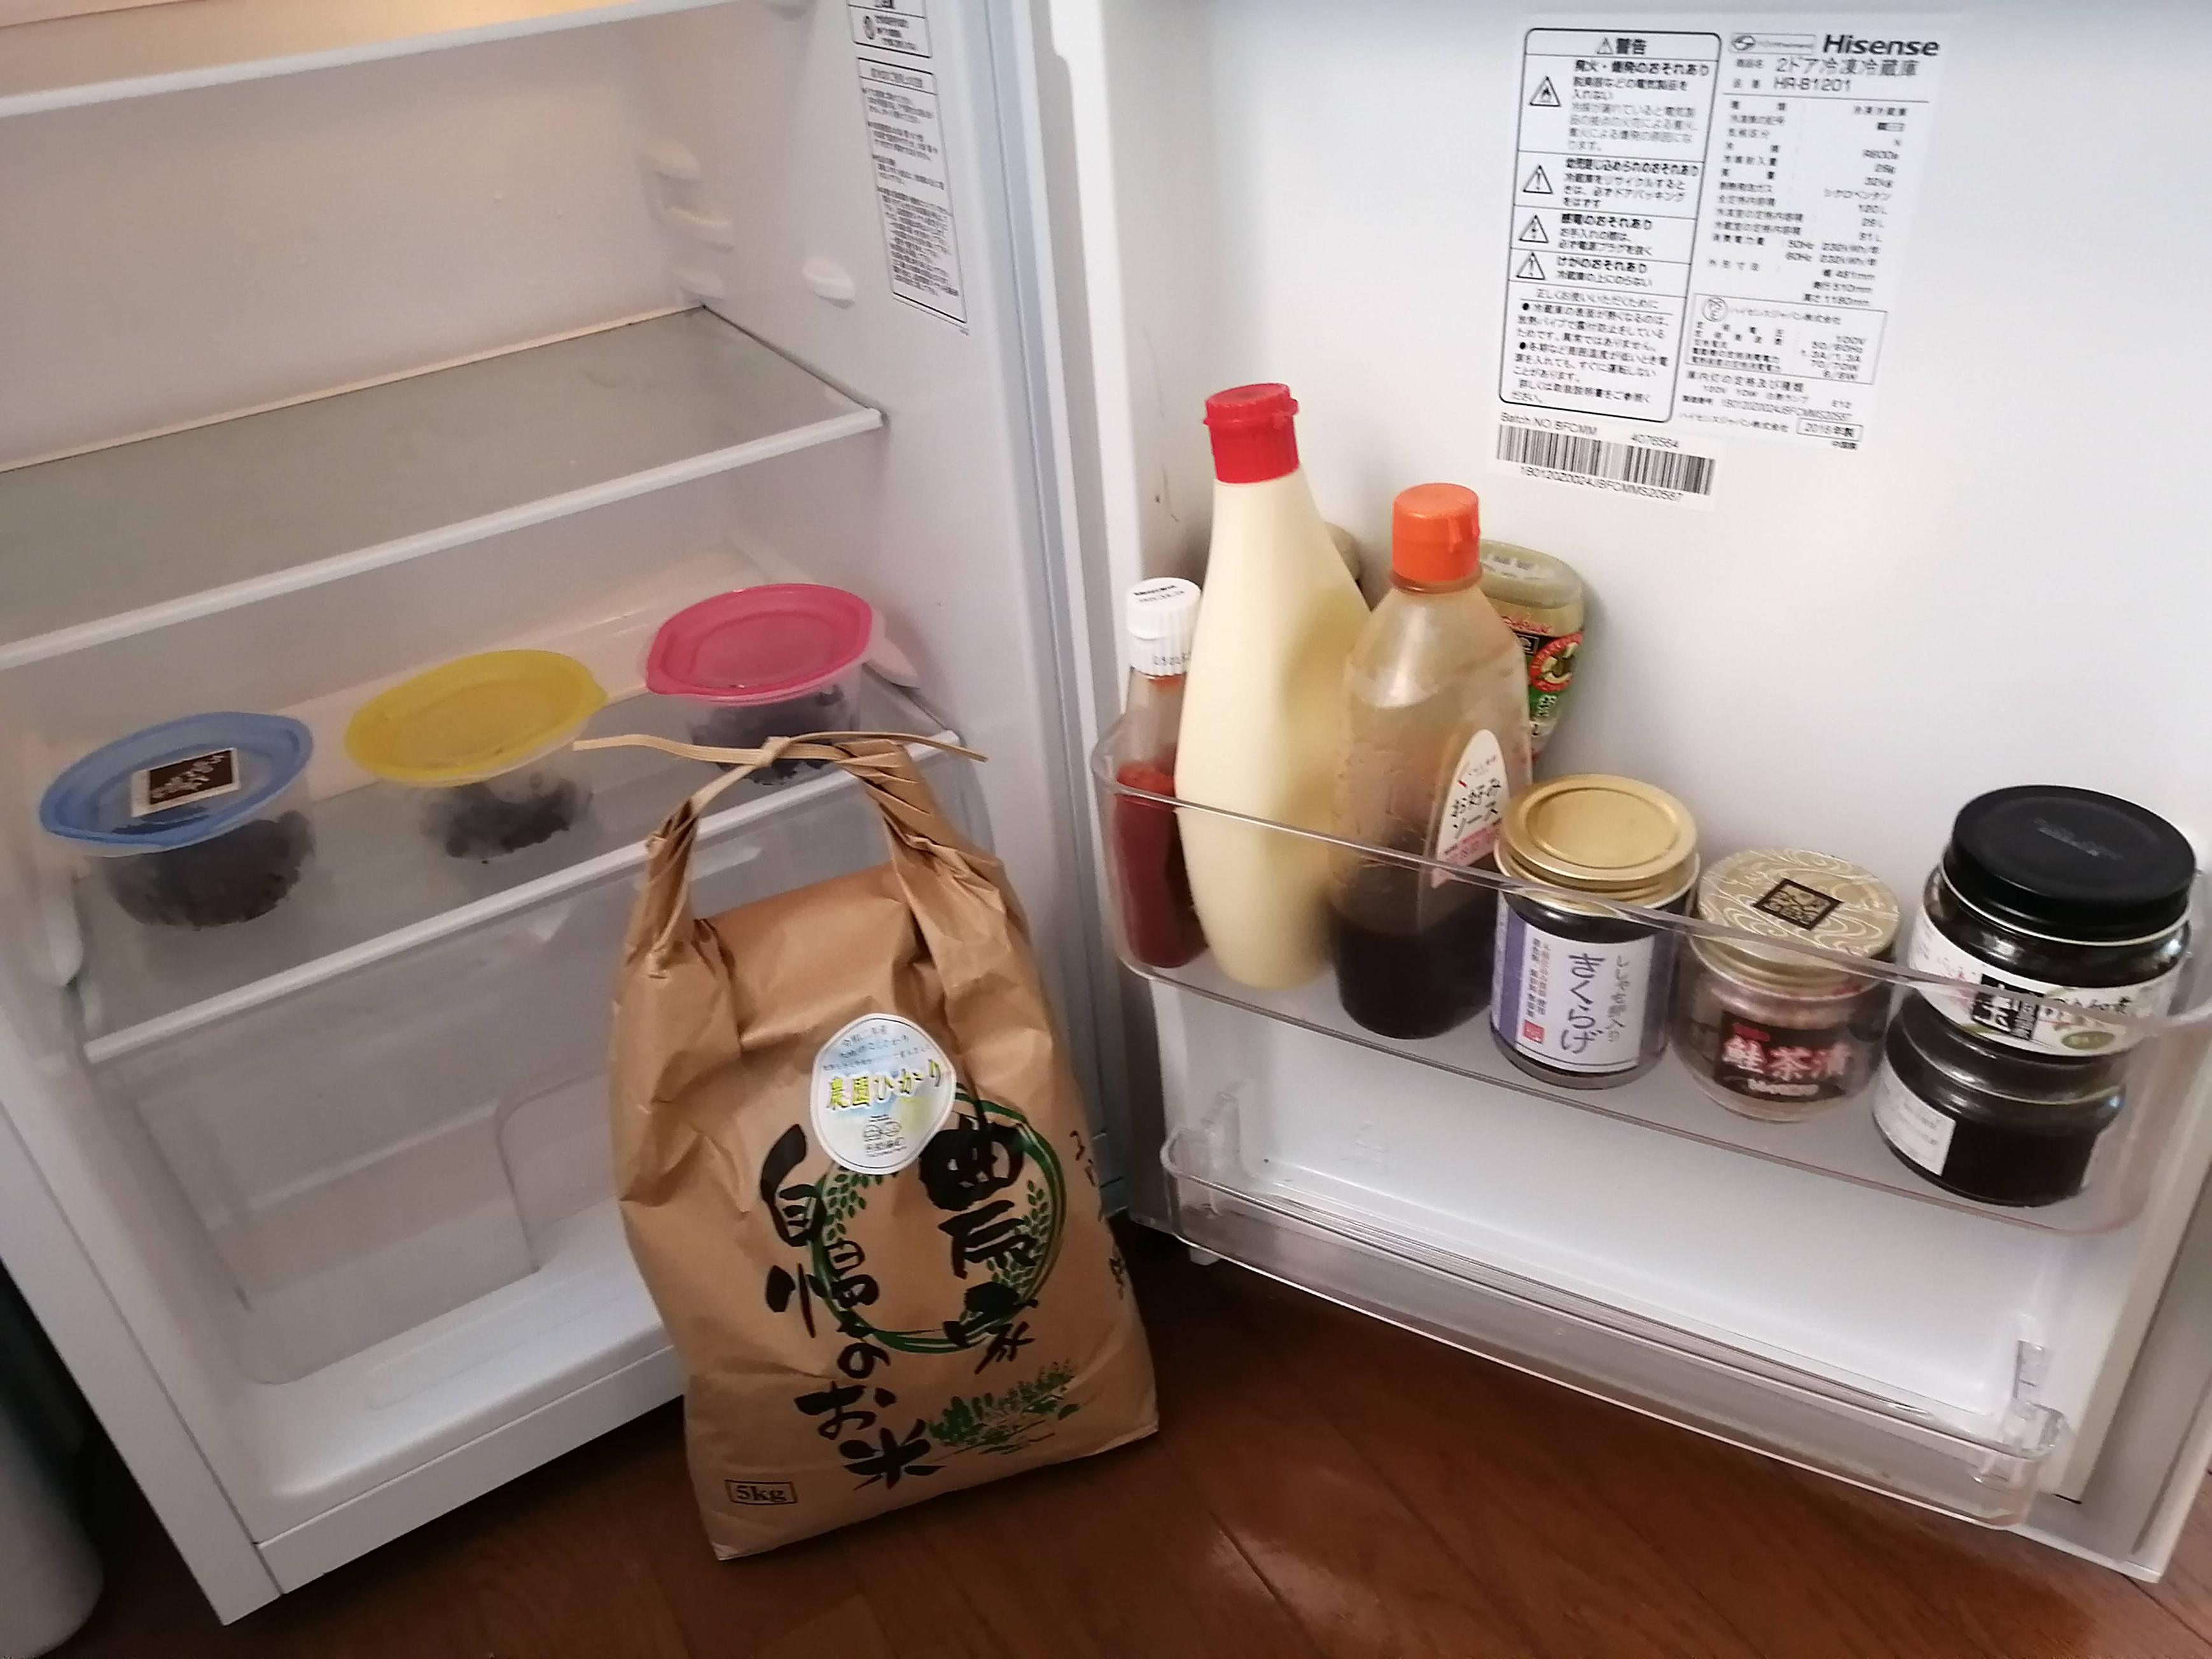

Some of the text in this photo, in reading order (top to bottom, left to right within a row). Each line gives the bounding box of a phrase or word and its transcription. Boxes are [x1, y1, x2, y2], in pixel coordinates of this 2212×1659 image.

[1822, 33, 1940, 56] Hisense
[1560, 952, 1606, 1054] きくらげ
[736, 1483, 787, 1503] 5kg
